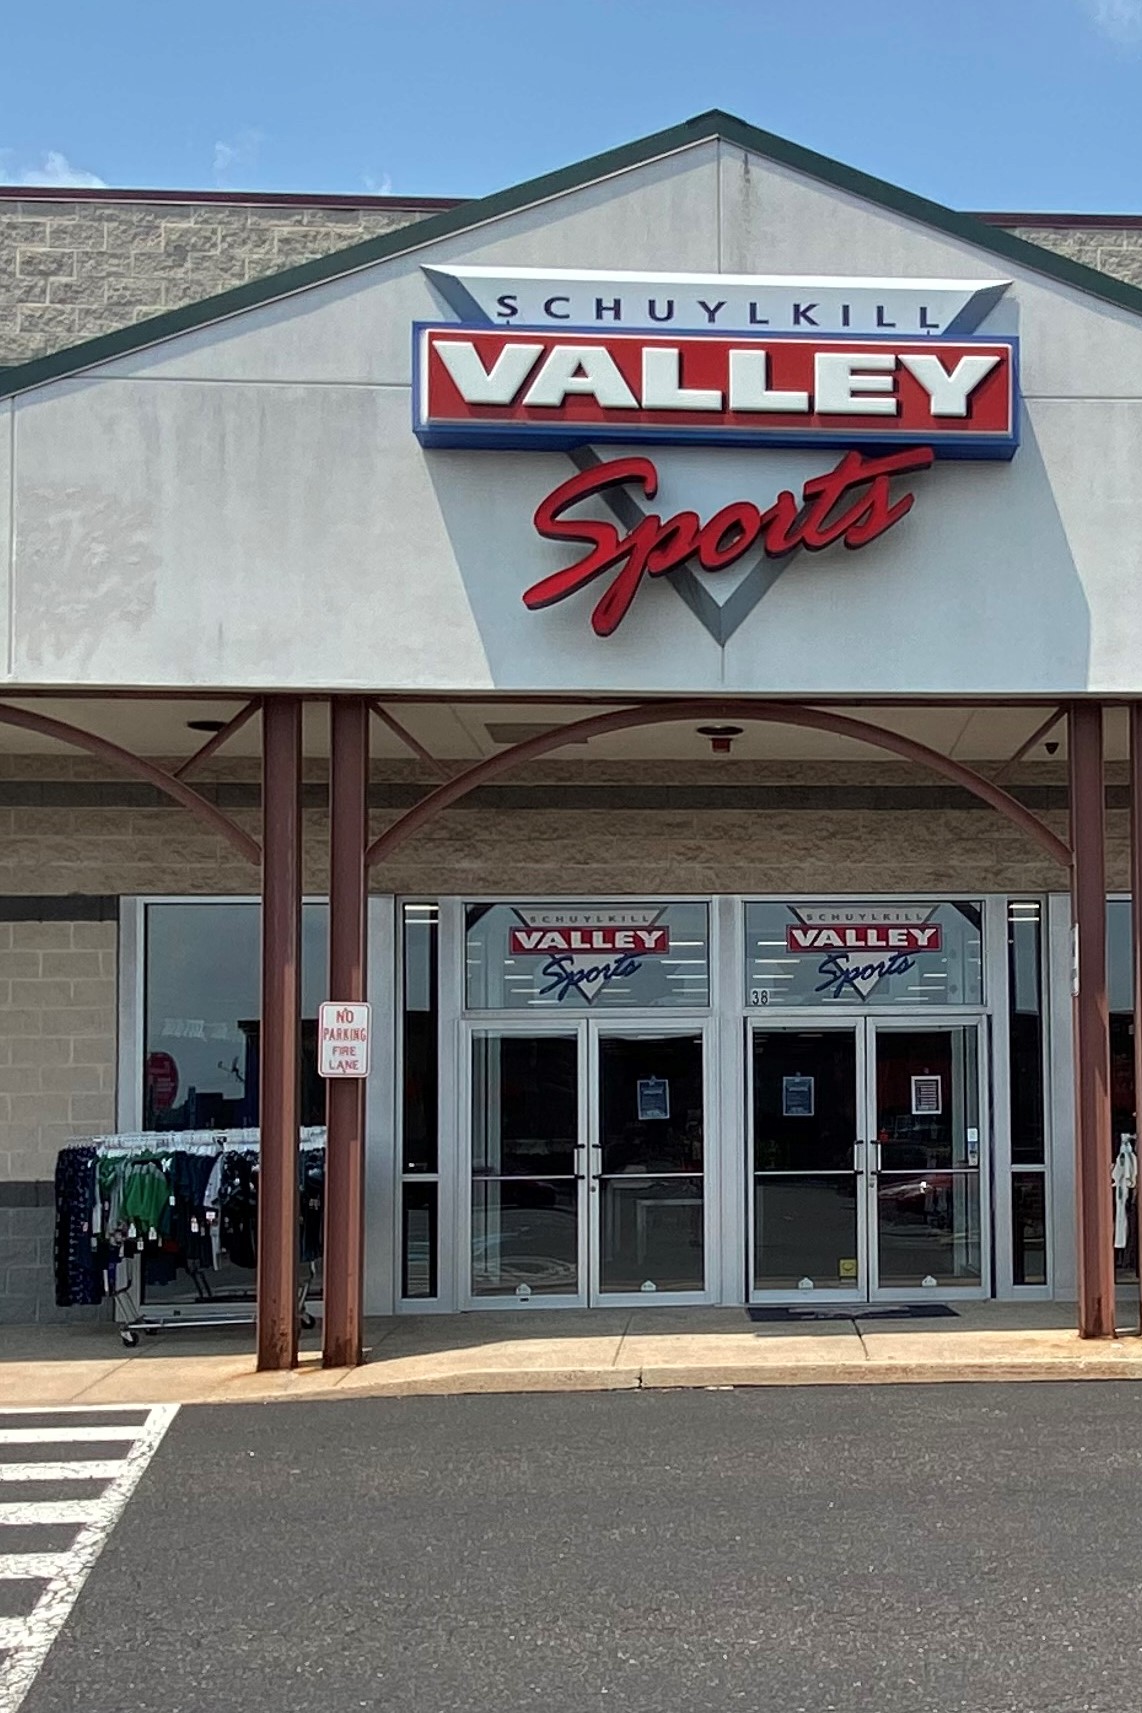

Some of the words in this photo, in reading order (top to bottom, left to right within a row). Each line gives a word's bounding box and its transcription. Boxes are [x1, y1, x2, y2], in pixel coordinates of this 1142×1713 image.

[496, 295, 940, 330] SCHUYLKILL
[432, 340, 1002, 417] VALLEY
[522, 446, 935, 637] Sports
[529, 915, 650, 924] SCHUYLKILL
[805, 912, 923, 922] SCHUYLKILL
[514, 931, 664, 949] VALLEY
[791, 928, 937, 947] VALLEY
[539, 952, 648, 1002] Sports
[815, 950, 921, 999] Sports
[752, 990, 768, 1006] 38
[335, 1010, 354, 1024] NO
[323, 1027, 367, 1042] PARKING
[332, 1046, 356, 1056] FIRE
[329, 1060, 359, 1070] LANE
